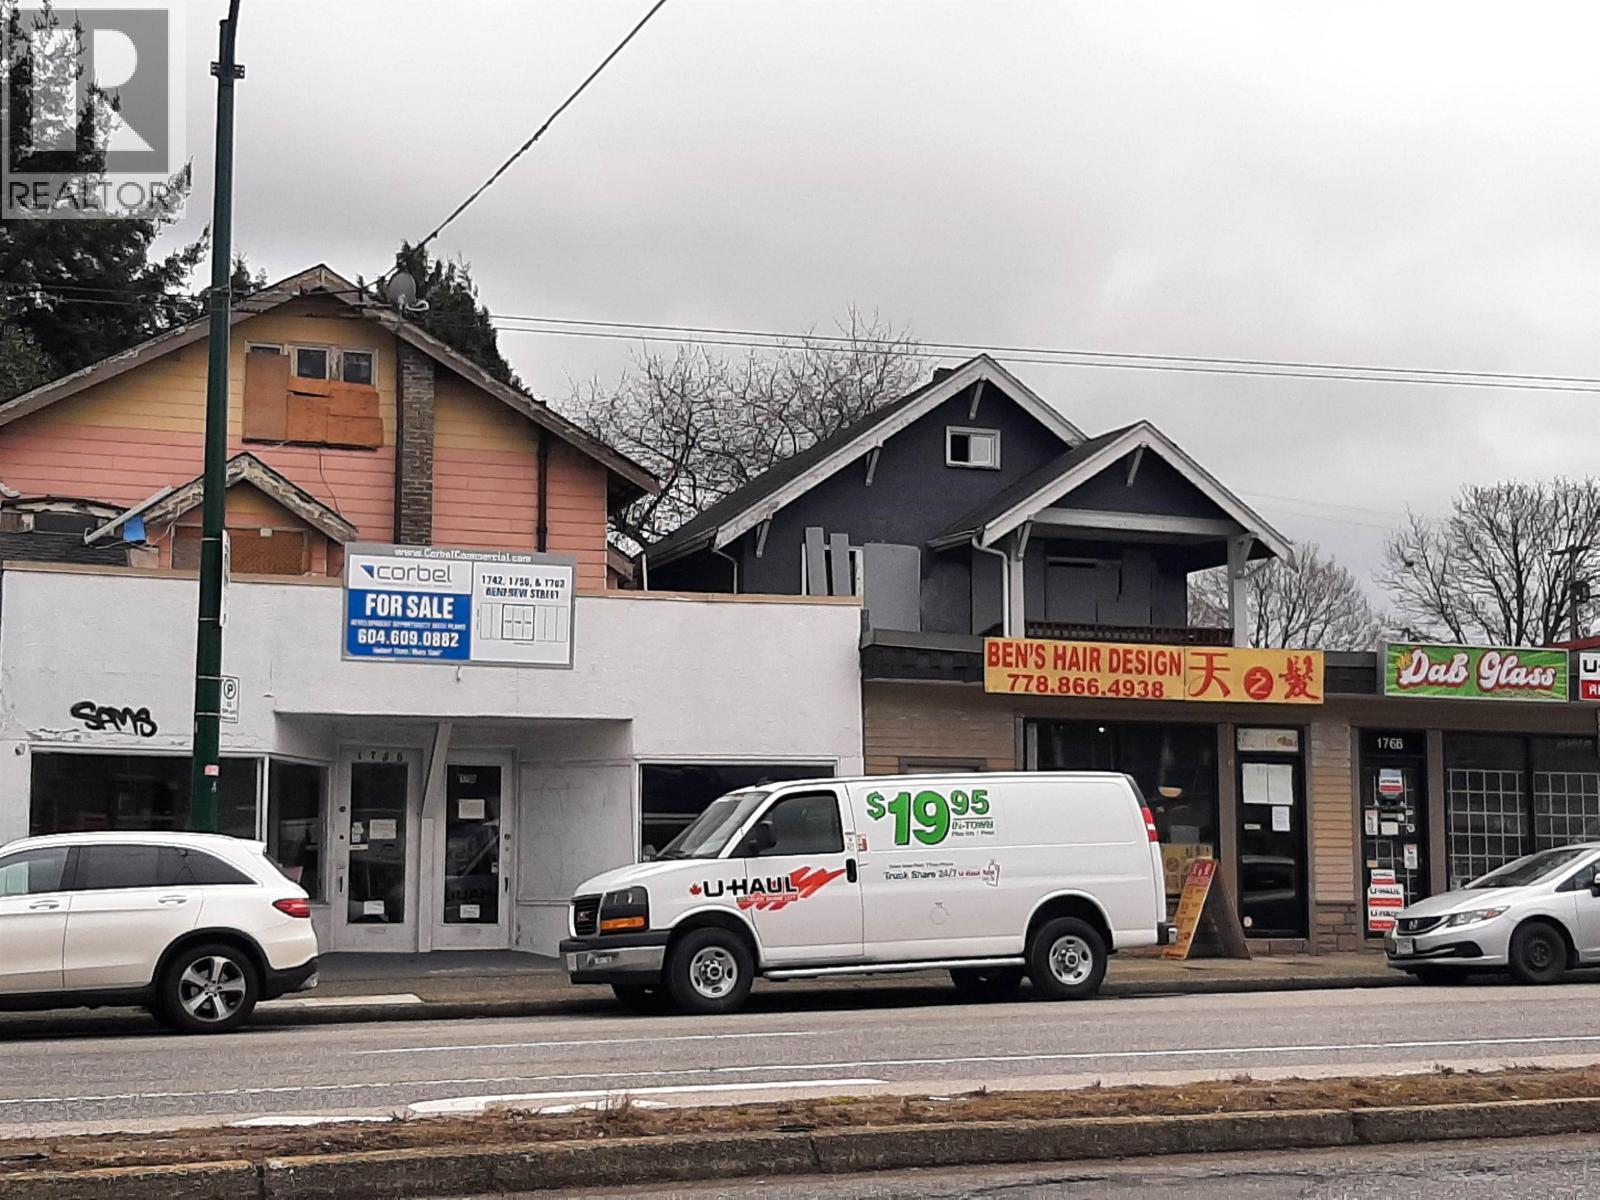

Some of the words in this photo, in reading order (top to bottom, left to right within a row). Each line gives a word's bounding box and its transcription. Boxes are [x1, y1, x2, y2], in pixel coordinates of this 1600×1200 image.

[394, 548, 532, 563] www.CorbelCommercial.com
[377, 564, 453, 583] corbel
[530, 589, 560, 599] STREET
[365, 593, 403, 617] FOR
[406, 595, 455, 619] SALE
[358, 628, 459, 648] 604.609.0882
[987, 641, 1046, 670] BEN'S
[1053, 644, 1101, 673] HAIR
[1108, 648, 1182, 677] DESIGN
[1397, 647, 1470, 688] Dab
[1478, 650, 1556, 690] Glass
[1007, 673, 1164, 699] 778.866.4938
[911, 870, 936, 879] Share
[703, 876, 798, 897] U-HAUL
